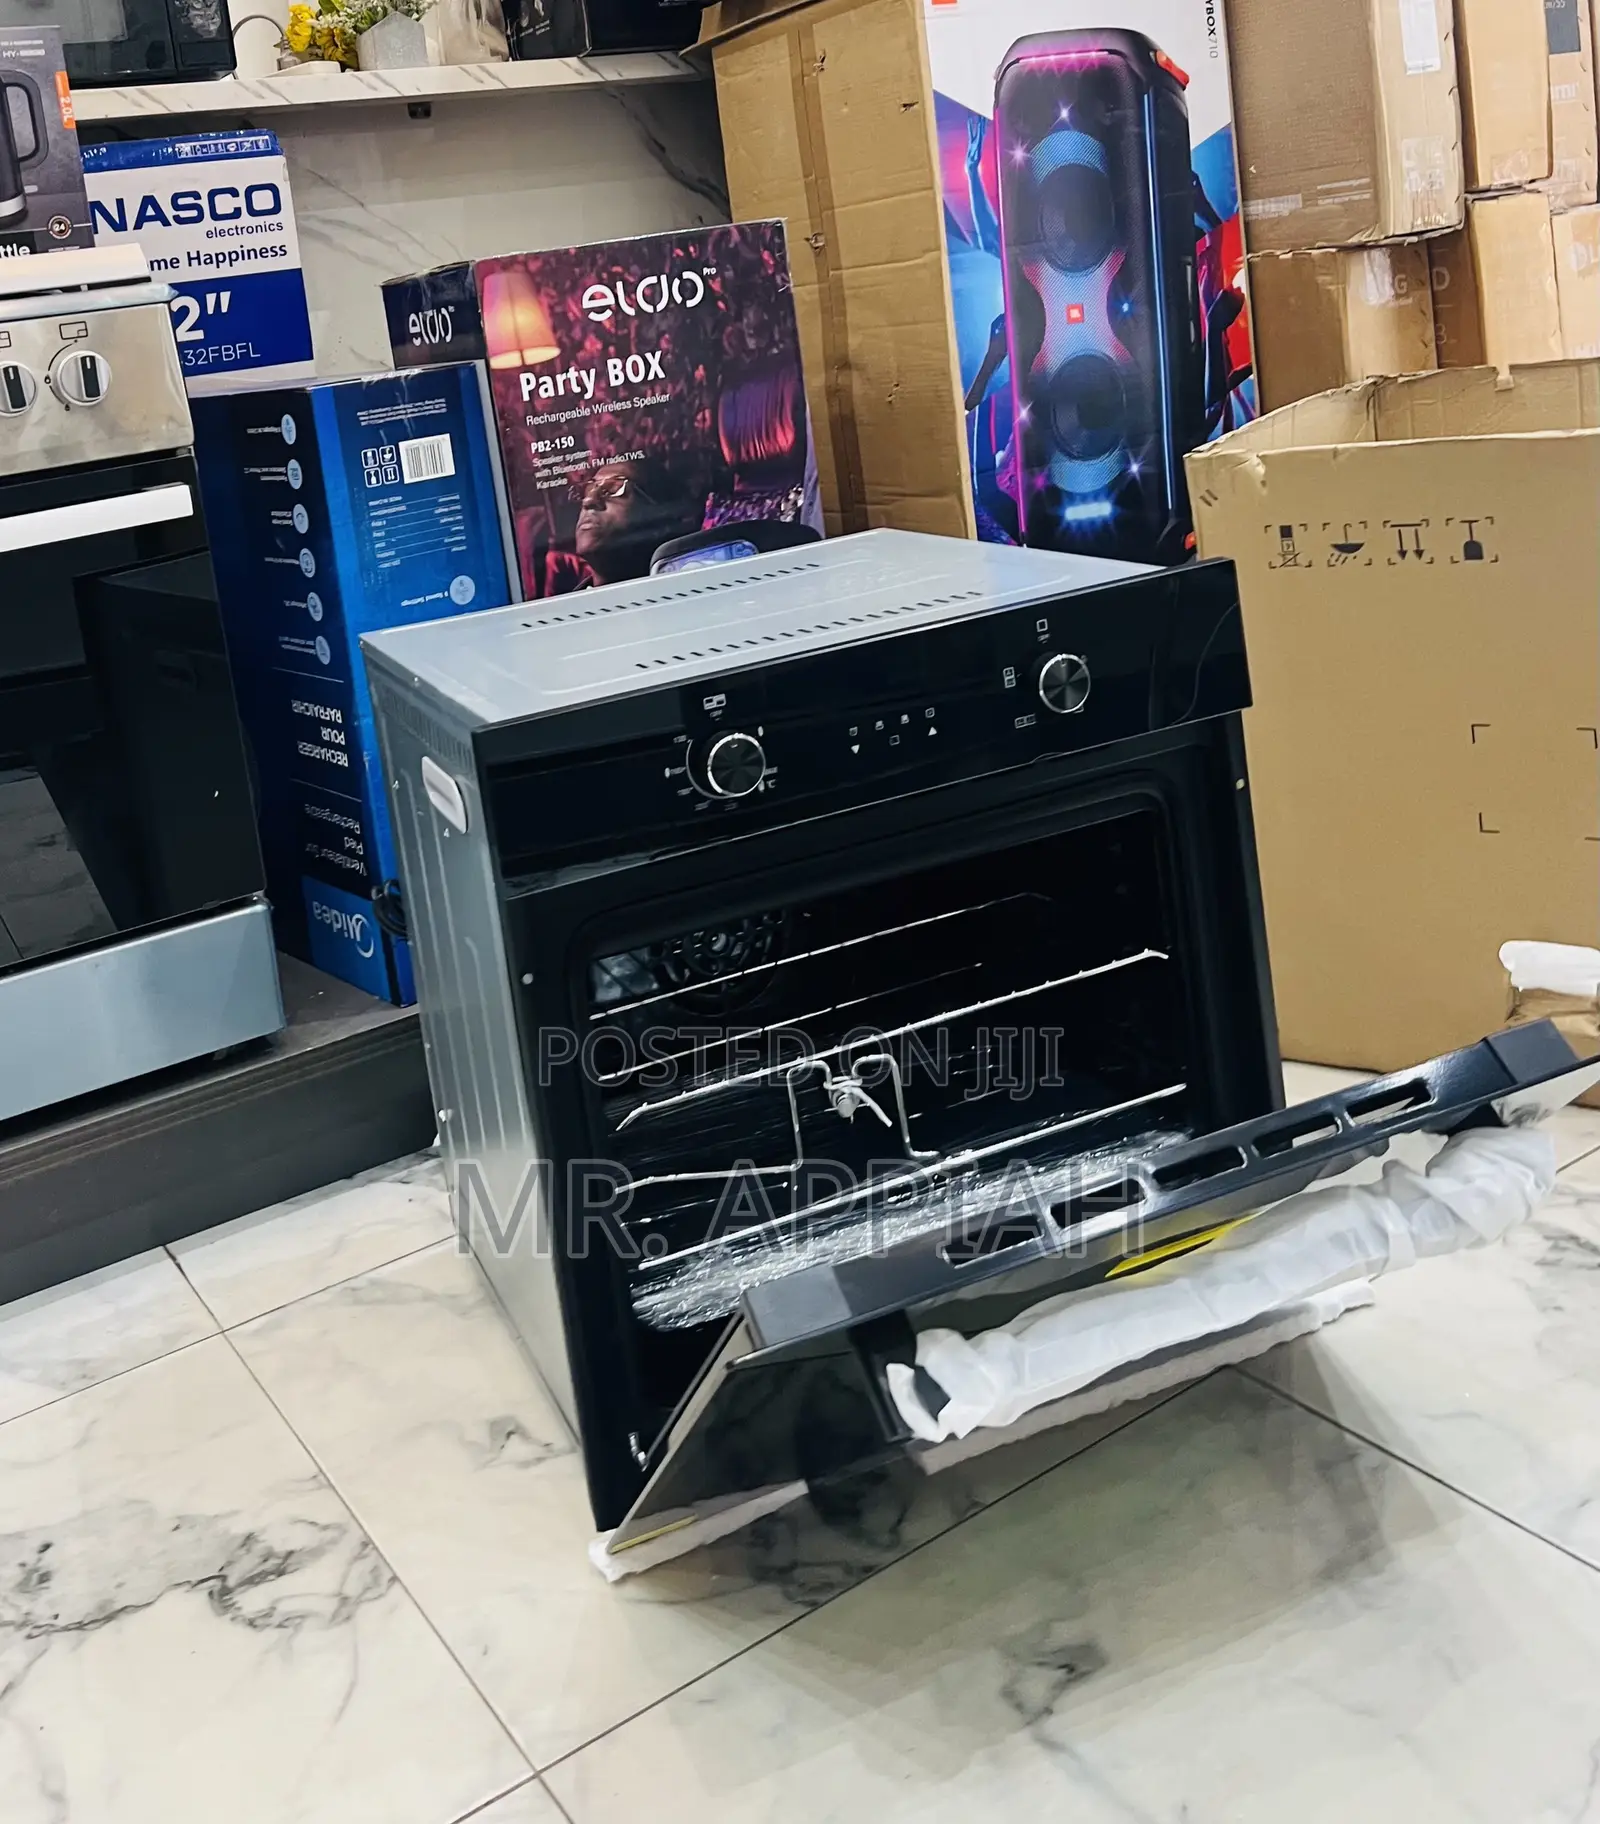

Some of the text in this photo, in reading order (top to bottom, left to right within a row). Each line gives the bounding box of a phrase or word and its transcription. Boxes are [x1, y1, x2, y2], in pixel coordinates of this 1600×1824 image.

[1205, 0, 1219, 59] YBOX710
[88, 183, 282, 234] NASCO
[206, 221, 284, 239] electronics
[0, 243, 31, 257] ttle
[147, 244, 287, 271] me Happiness
[703, 267, 717, 276] Pro
[170, 291, 231, 342] 2"
[180, 342, 261, 366] 32FBFL
[519, 350, 666, 402] Party BOX
[526, 393, 671, 426] Rechargeable Wireless Speaker
[531, 435, 575, 454] PB2-150
[320, 727, 345, 745] POUR
[313, 899, 374, 958] Midea
